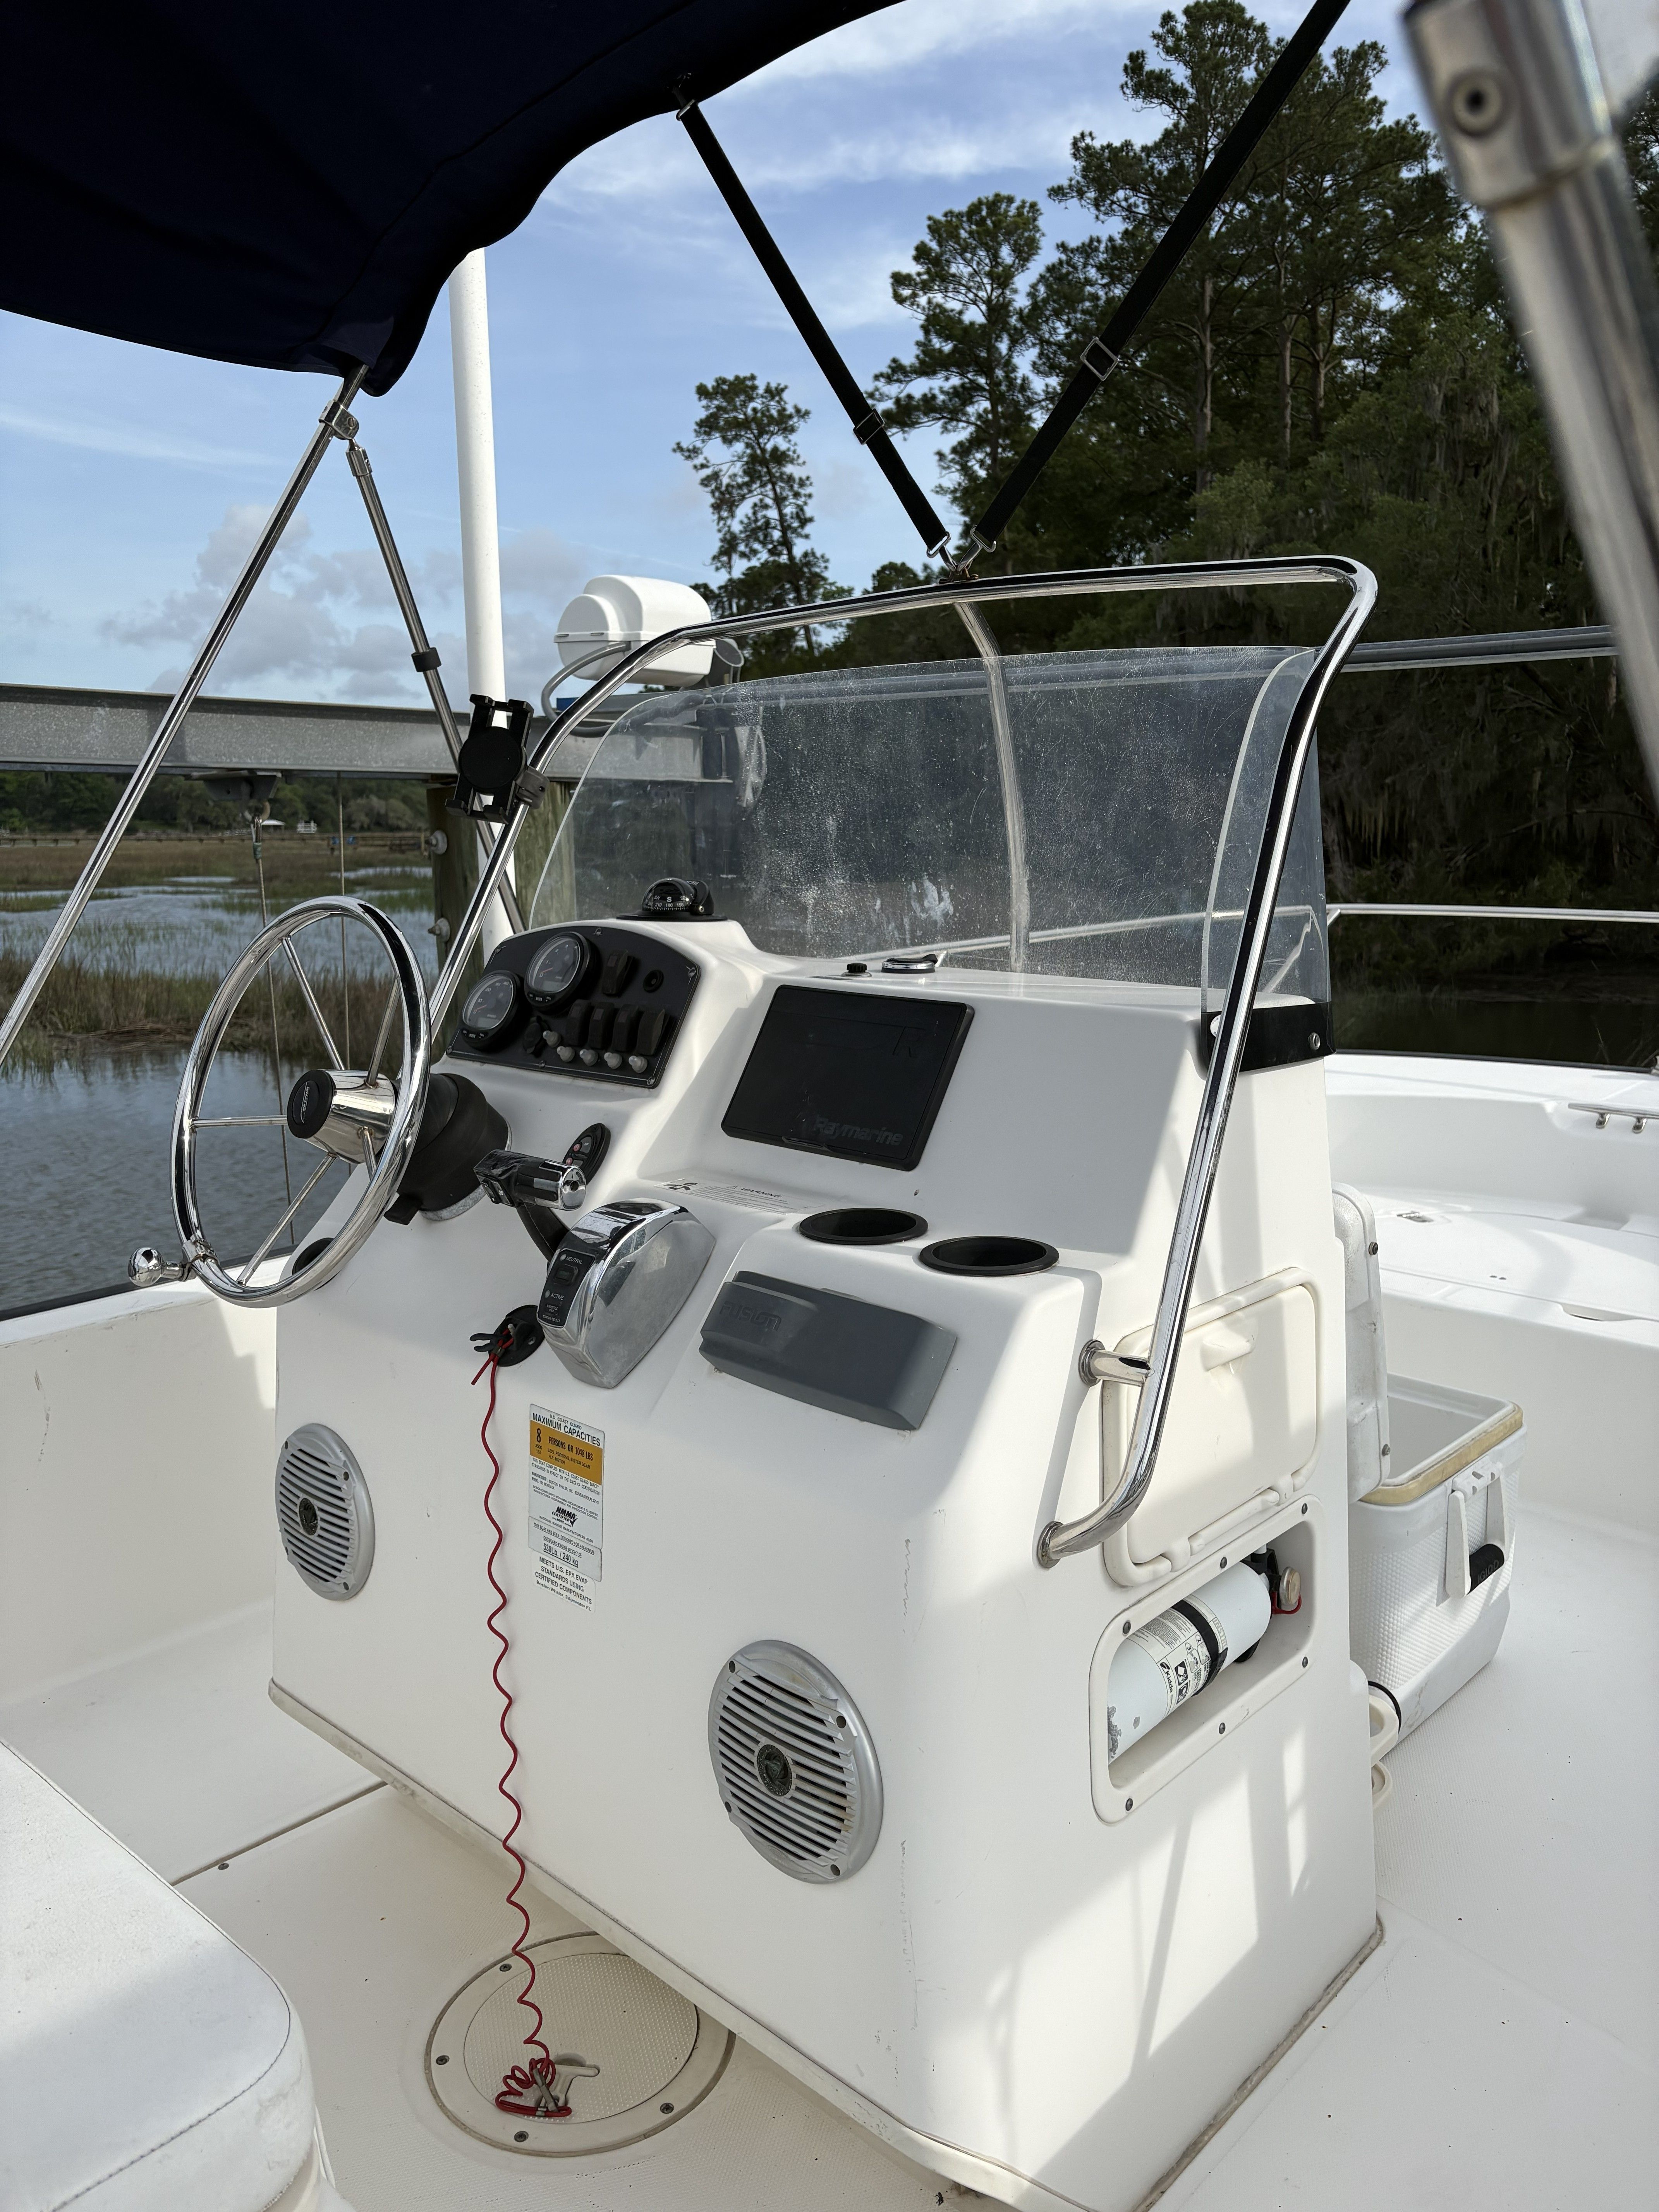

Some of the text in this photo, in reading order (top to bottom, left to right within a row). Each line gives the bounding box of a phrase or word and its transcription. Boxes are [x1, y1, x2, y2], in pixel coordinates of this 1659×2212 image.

[814, 1114, 904, 1146] Raymarine
[566, 1256, 582, 1264] NEUTRAL
[532, 1413, 600, 1446] MAXIMUM CAPACITIES
[537, 1428, 541, 1443] 8
[548, 1436, 566, 1449] PERSONS
[568, 1444, 573, 1453] OR
[575, 1446, 585, 1457] 1048
[555, 1457, 565, 1465] MOTOR
[570, 1457, 581, 1465] MOTOR
[551, 1511, 570, 1522] CERTIFIED
[543, 1543, 559, 1557] 530Lb.
[563, 1552, 571, 1562] 240
[572, 1557, 579, 1566] kg
[539, 1556, 588, 1584] MEETS U.S. EPA EVAP
[541, 1566, 584, 1592] STANDARDS USING
[535, 1571, 592, 1605] CERTIFIED COMPONENTS
[536, 1580, 550, 1590] Boston
[550, 1587, 564, 1598] Whaler,
[565, 1595, 585, 1608] Edgewater
[1165, 1670, 1173, 1693] Kidde
